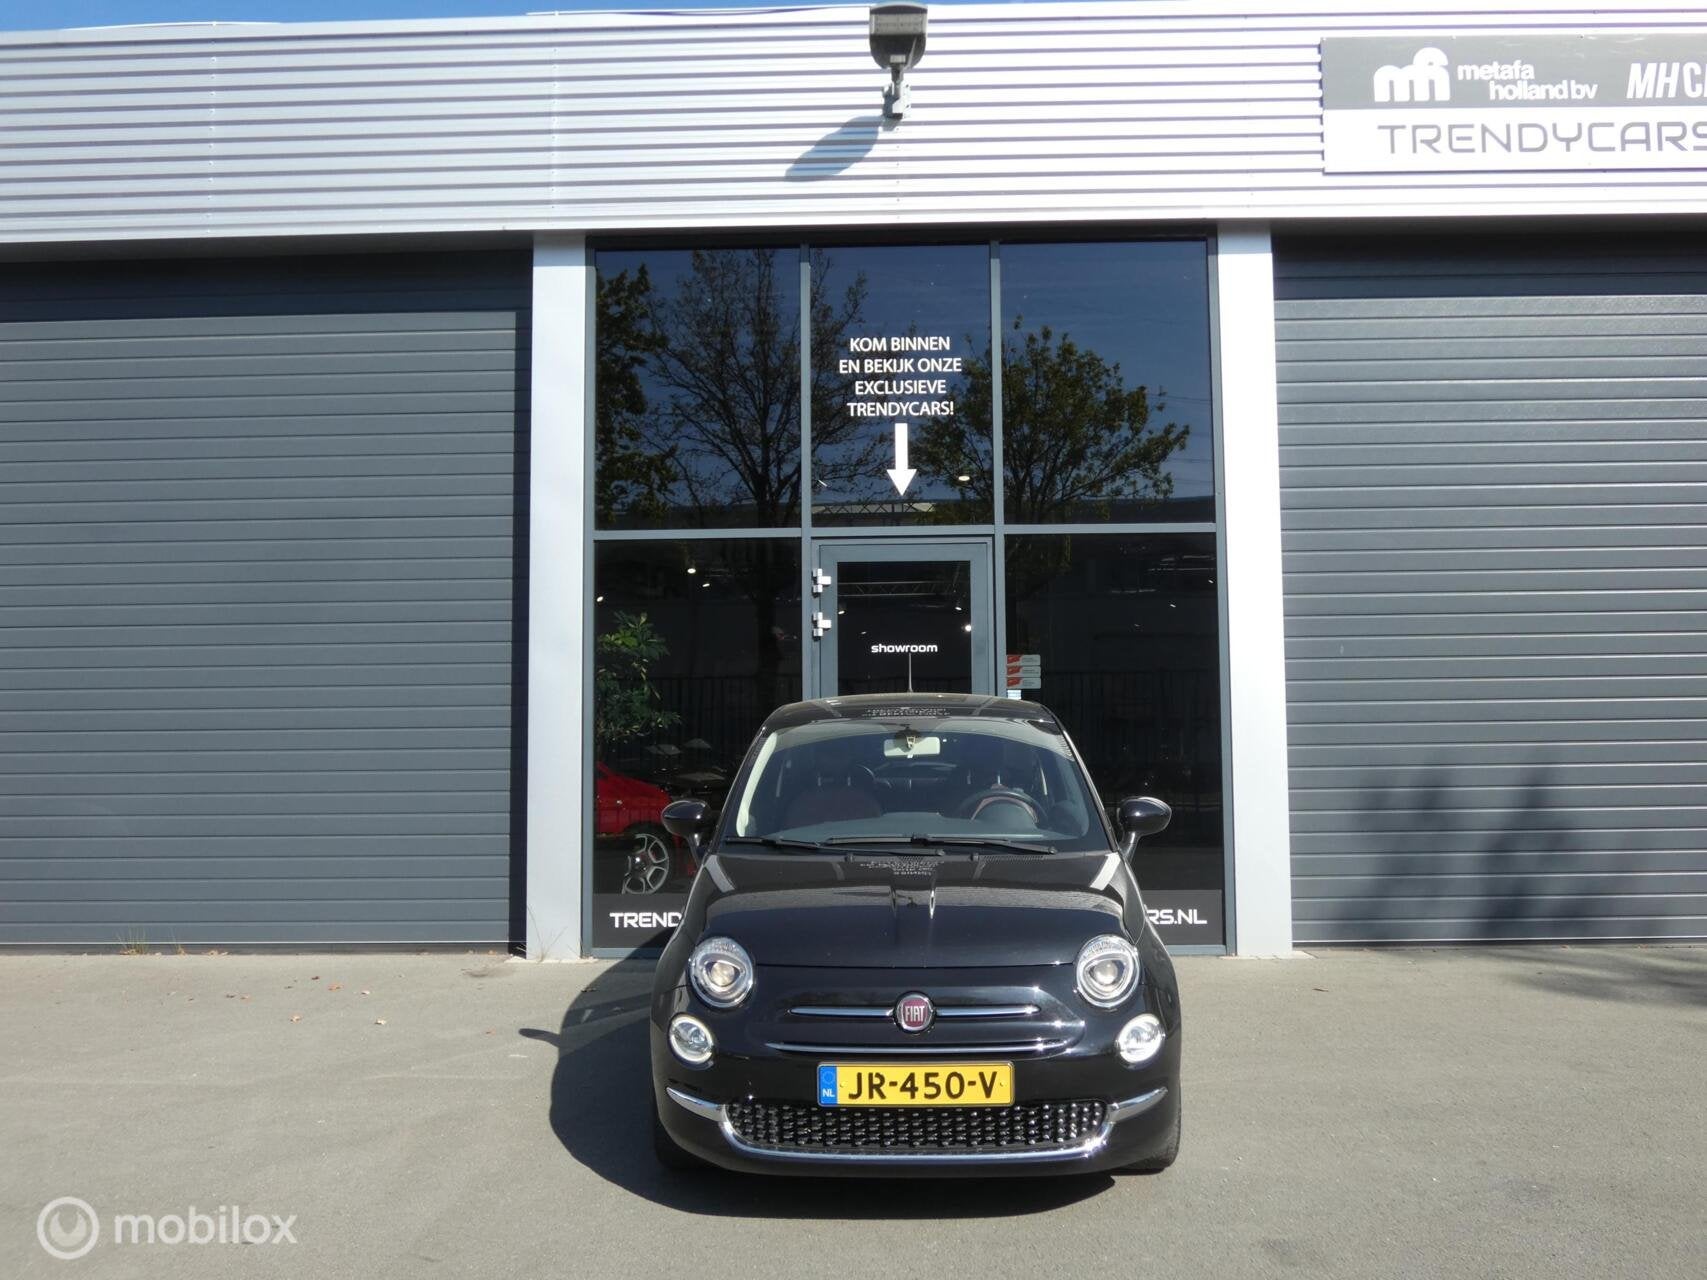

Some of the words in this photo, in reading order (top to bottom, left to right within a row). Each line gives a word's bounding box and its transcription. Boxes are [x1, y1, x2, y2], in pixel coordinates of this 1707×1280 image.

[1457, 59, 1535, 80] metafa
[1626, 62, 1707, 99] MHC
[1377, 121, 1707, 154] TRENDYCARS
[850, 337, 887, 352] KOM
[890, 336, 951, 351] BINNEN
[839, 359, 860, 374] EN
[864, 358, 914, 373] BEKIJK
[917, 357, 962, 372] ONZE
[855, 379, 947, 395] EXCLUSIEVE
[847, 401, 954, 417] TRENDYCARS!
[871, 643, 938, 653] showroom
[904, 1005, 926, 1022] FIAT
[822, 1088, 836, 1098] NL
[848, 1071, 998, 1100] JR-450-V
